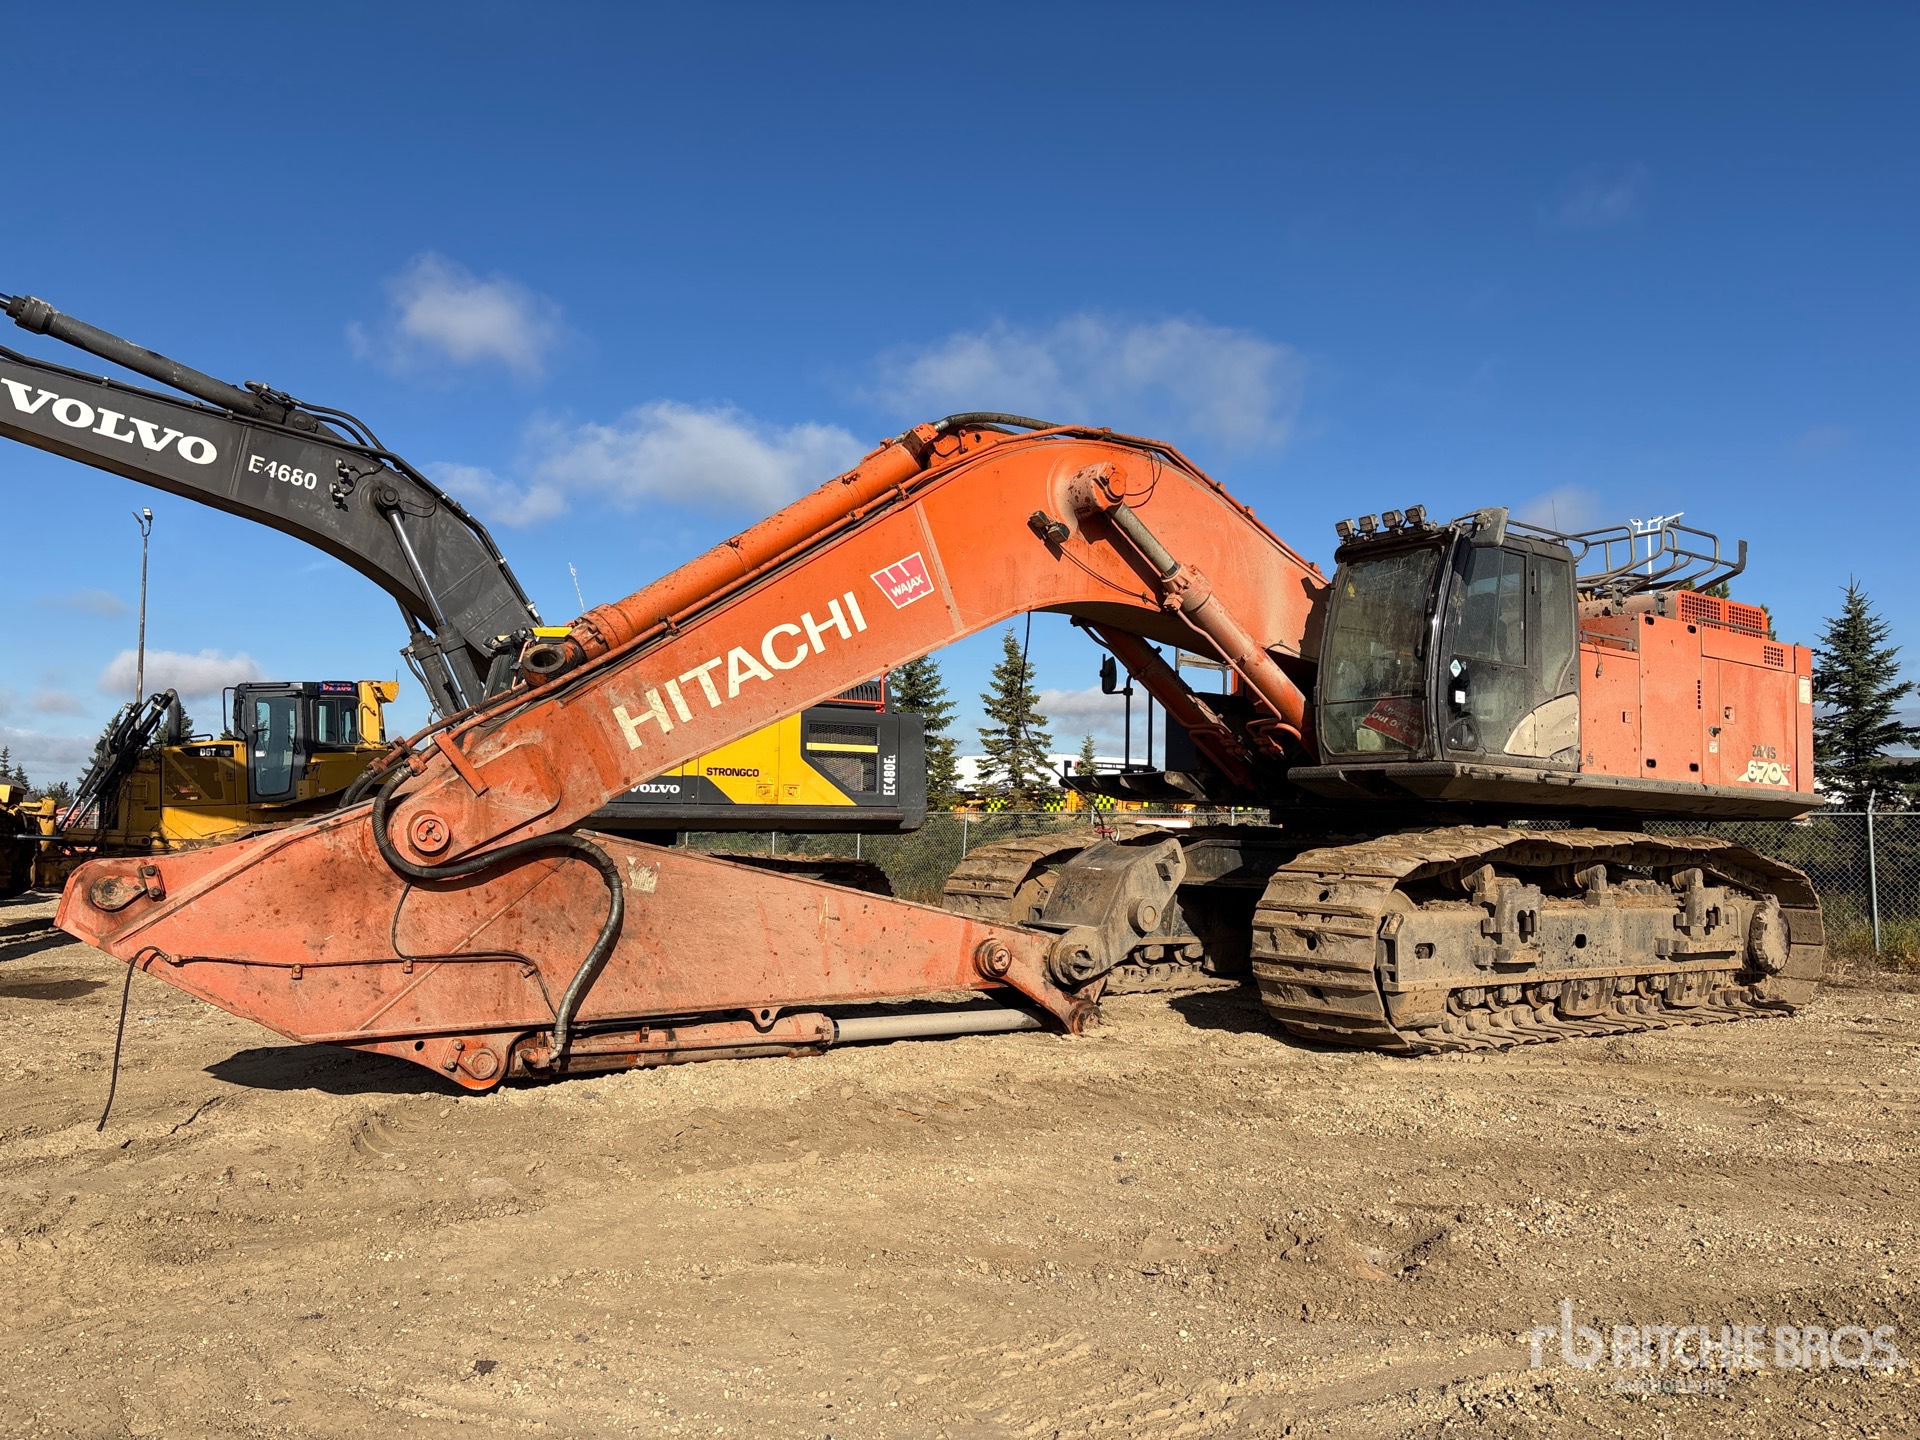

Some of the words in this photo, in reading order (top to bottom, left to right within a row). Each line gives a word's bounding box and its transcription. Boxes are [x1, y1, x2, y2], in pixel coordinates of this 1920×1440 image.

[1, 377, 218, 465] VOLVO
[248, 454, 318, 491] E4680
[890, 573, 925, 598] WAJAX
[612, 591, 868, 751] HITACHI
[1371, 711, 1389, 724] Out
[199, 747, 217, 757] D6T
[706, 767, 760, 778] STRONGCO
